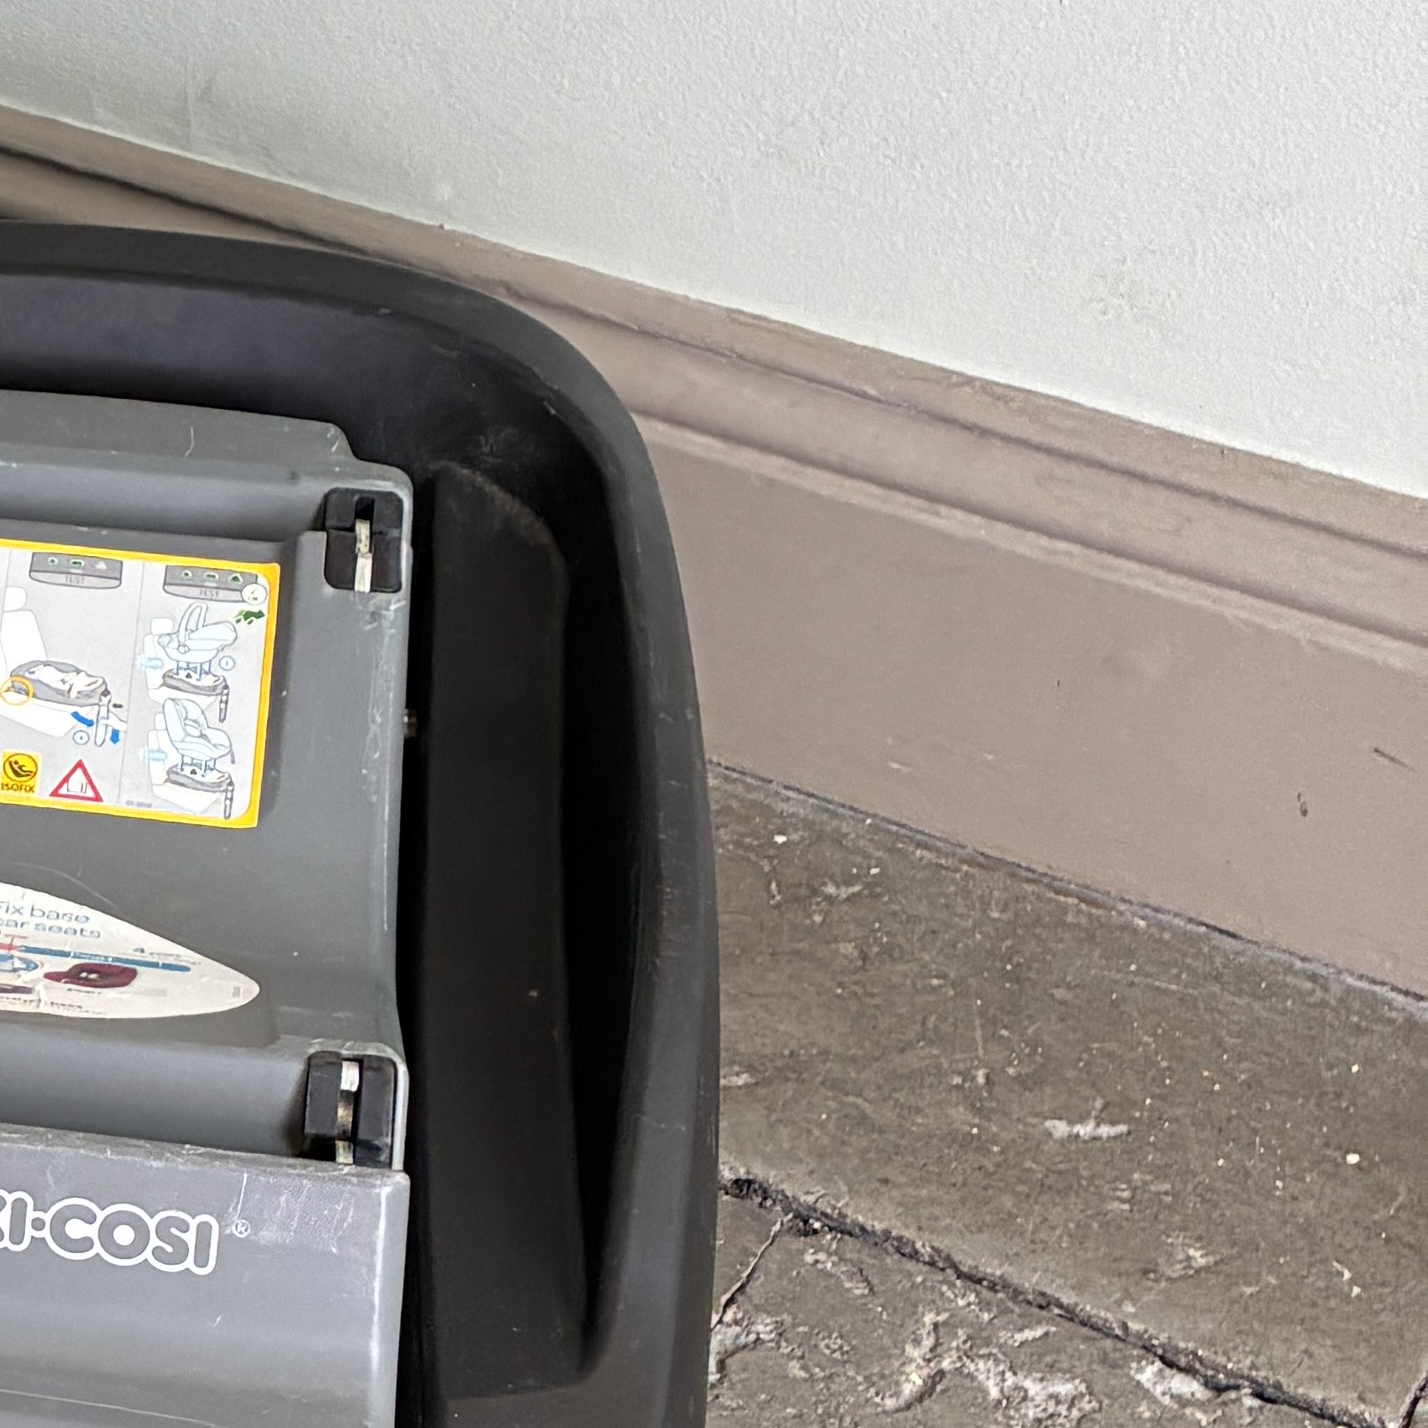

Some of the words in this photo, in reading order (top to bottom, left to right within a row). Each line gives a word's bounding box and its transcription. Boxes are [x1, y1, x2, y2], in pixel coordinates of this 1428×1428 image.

[0, 782, 36, 794] ISOFIX
[30, 904, 90, 923] base
[34, 922, 101, 939] seats
